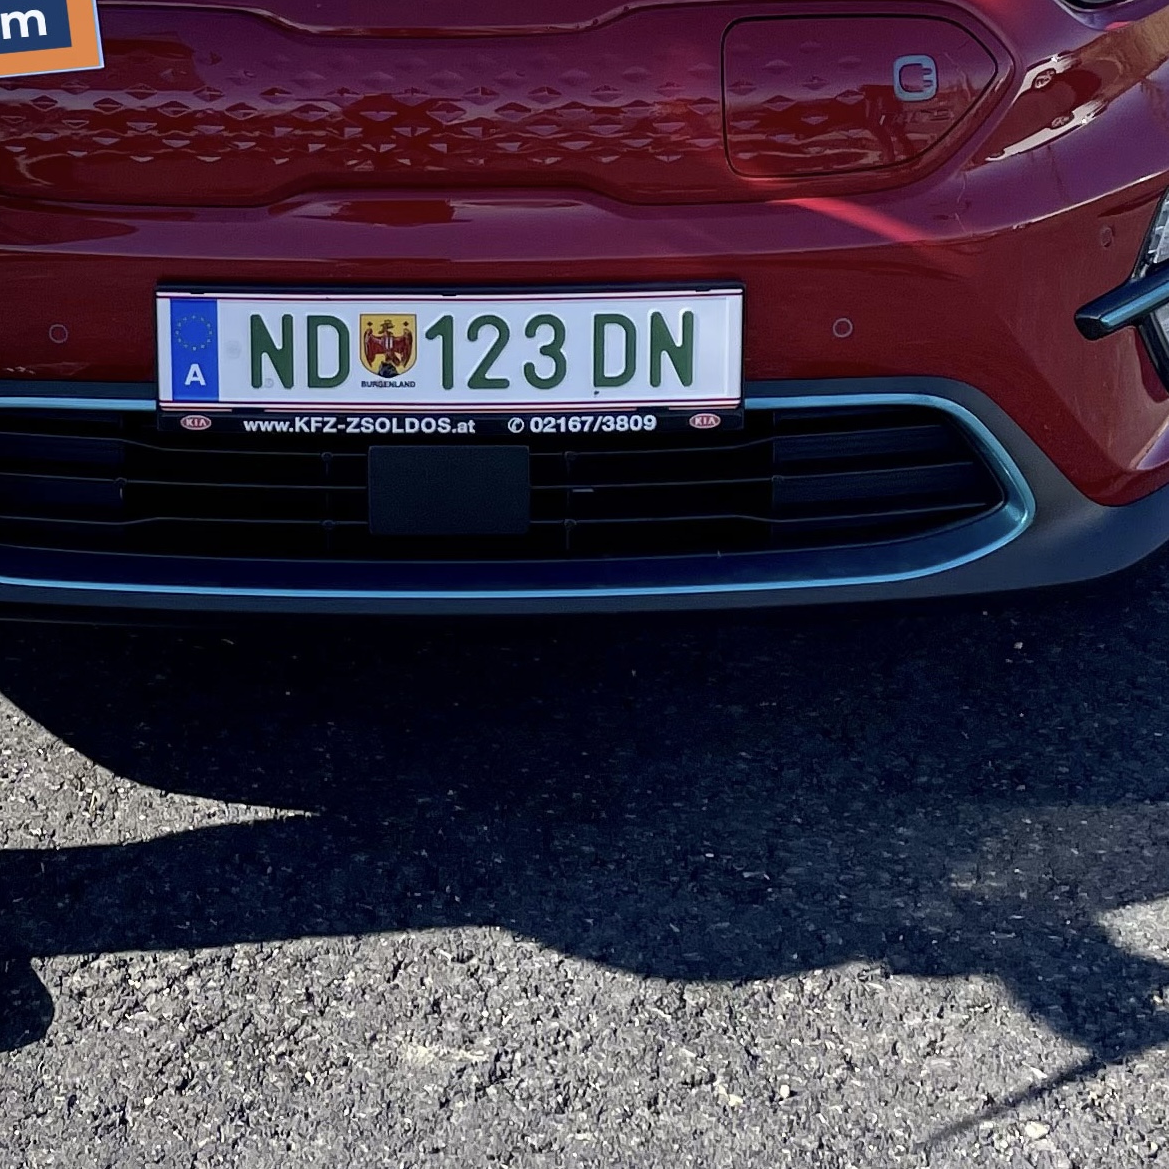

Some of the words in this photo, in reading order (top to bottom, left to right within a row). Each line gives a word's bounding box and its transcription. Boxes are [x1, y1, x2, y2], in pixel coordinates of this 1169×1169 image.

[250, 313, 351, 390] ND
[425, 314, 567, 390] 123
[593, 310, 695, 388] DN
[184, 363, 206, 386] A
[360, 380, 417, 388] BURGENLAND
[185, 418, 207, 427] KIA
[243, 416, 476, 434] www.KFZ-ZSOLDOS.at
[529, 414, 657, 433] 02167/3809
[694, 416, 716, 426] KIA
